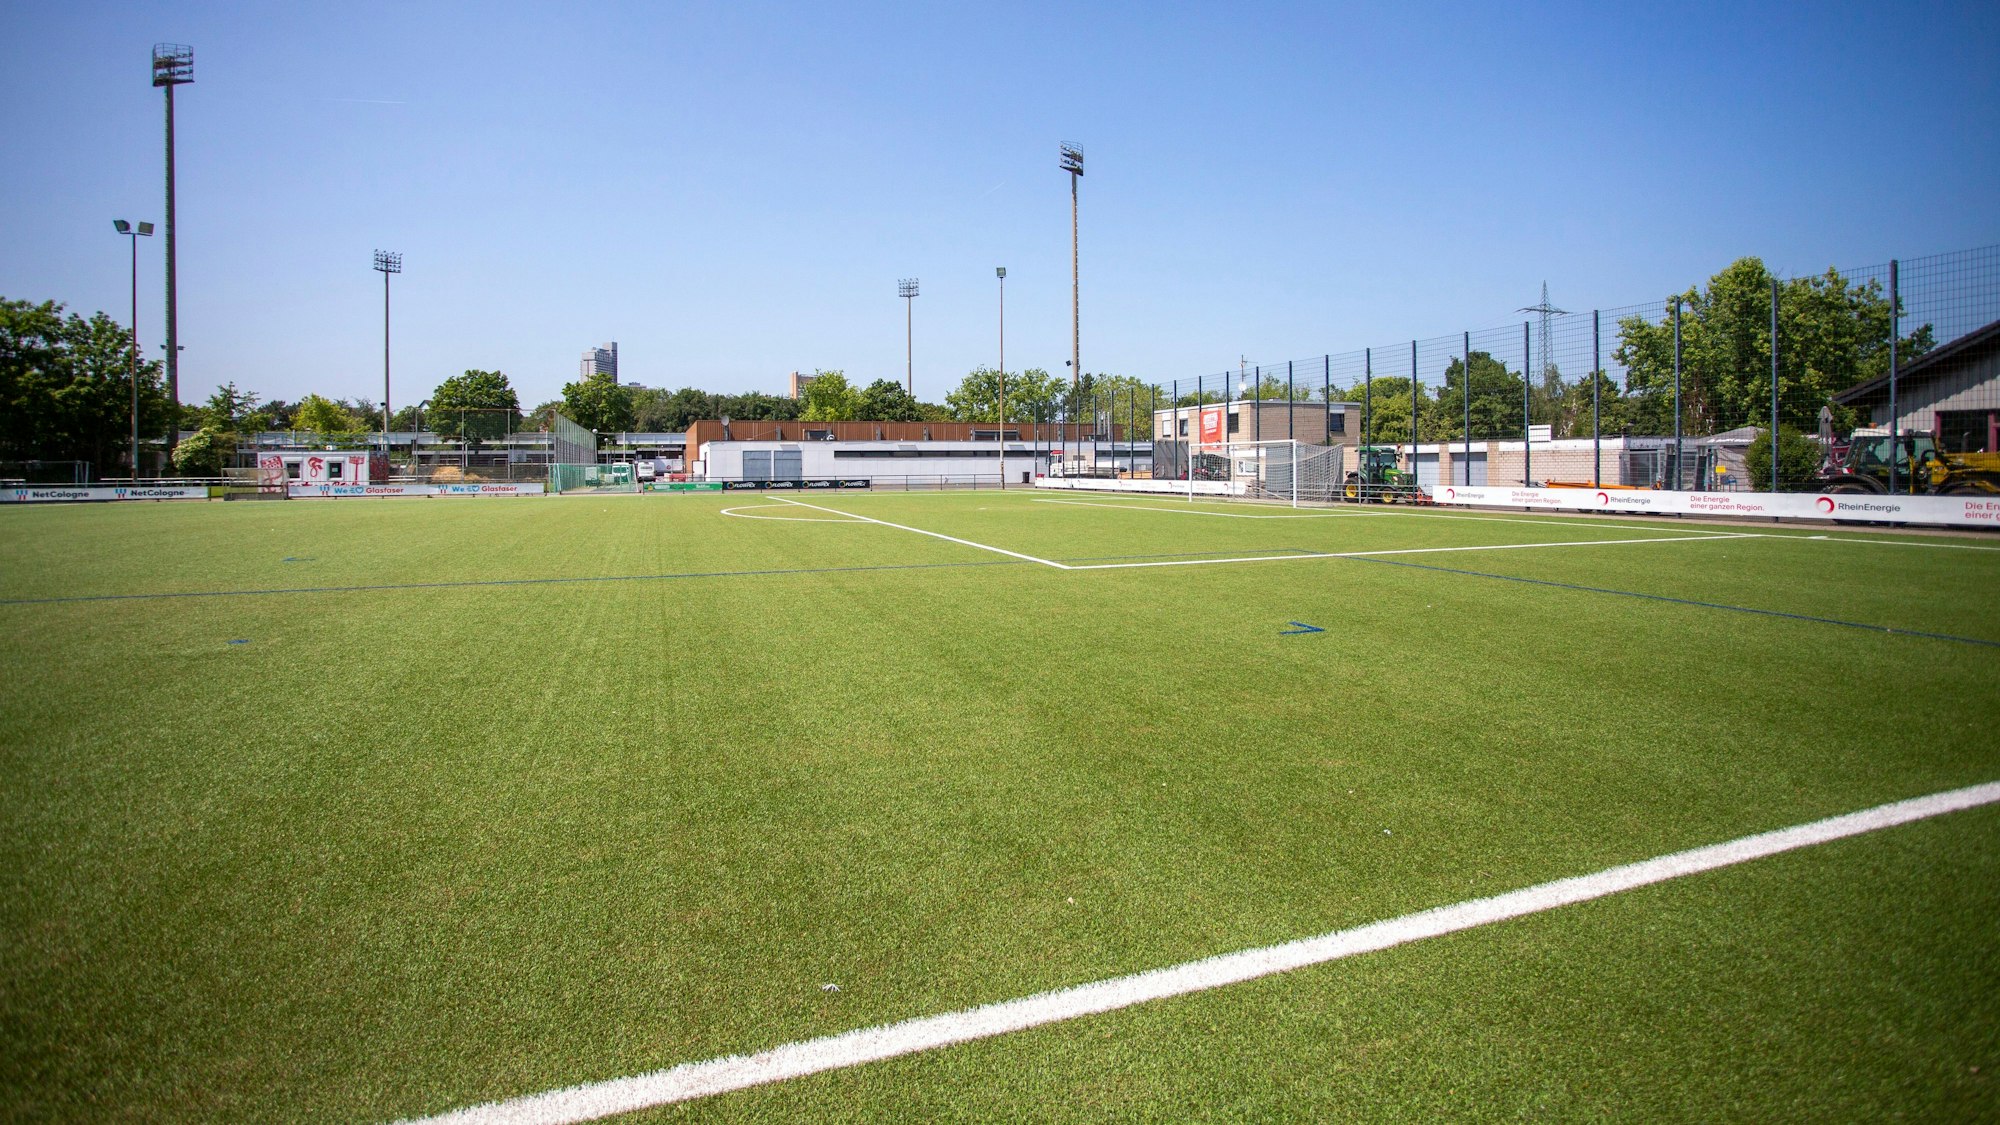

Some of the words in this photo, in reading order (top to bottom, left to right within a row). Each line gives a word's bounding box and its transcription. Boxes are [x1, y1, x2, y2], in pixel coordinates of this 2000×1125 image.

[32, 491, 90, 499] NetCologne
[131, 489, 185, 498] NetCologne
[1610, 496, 1651, 505] RheinEnergie
[1838, 502, 1901, 513] RheinEnergie
[1965, 502, 1983, 510] Die
[1965, 511, 1993, 519] einer
